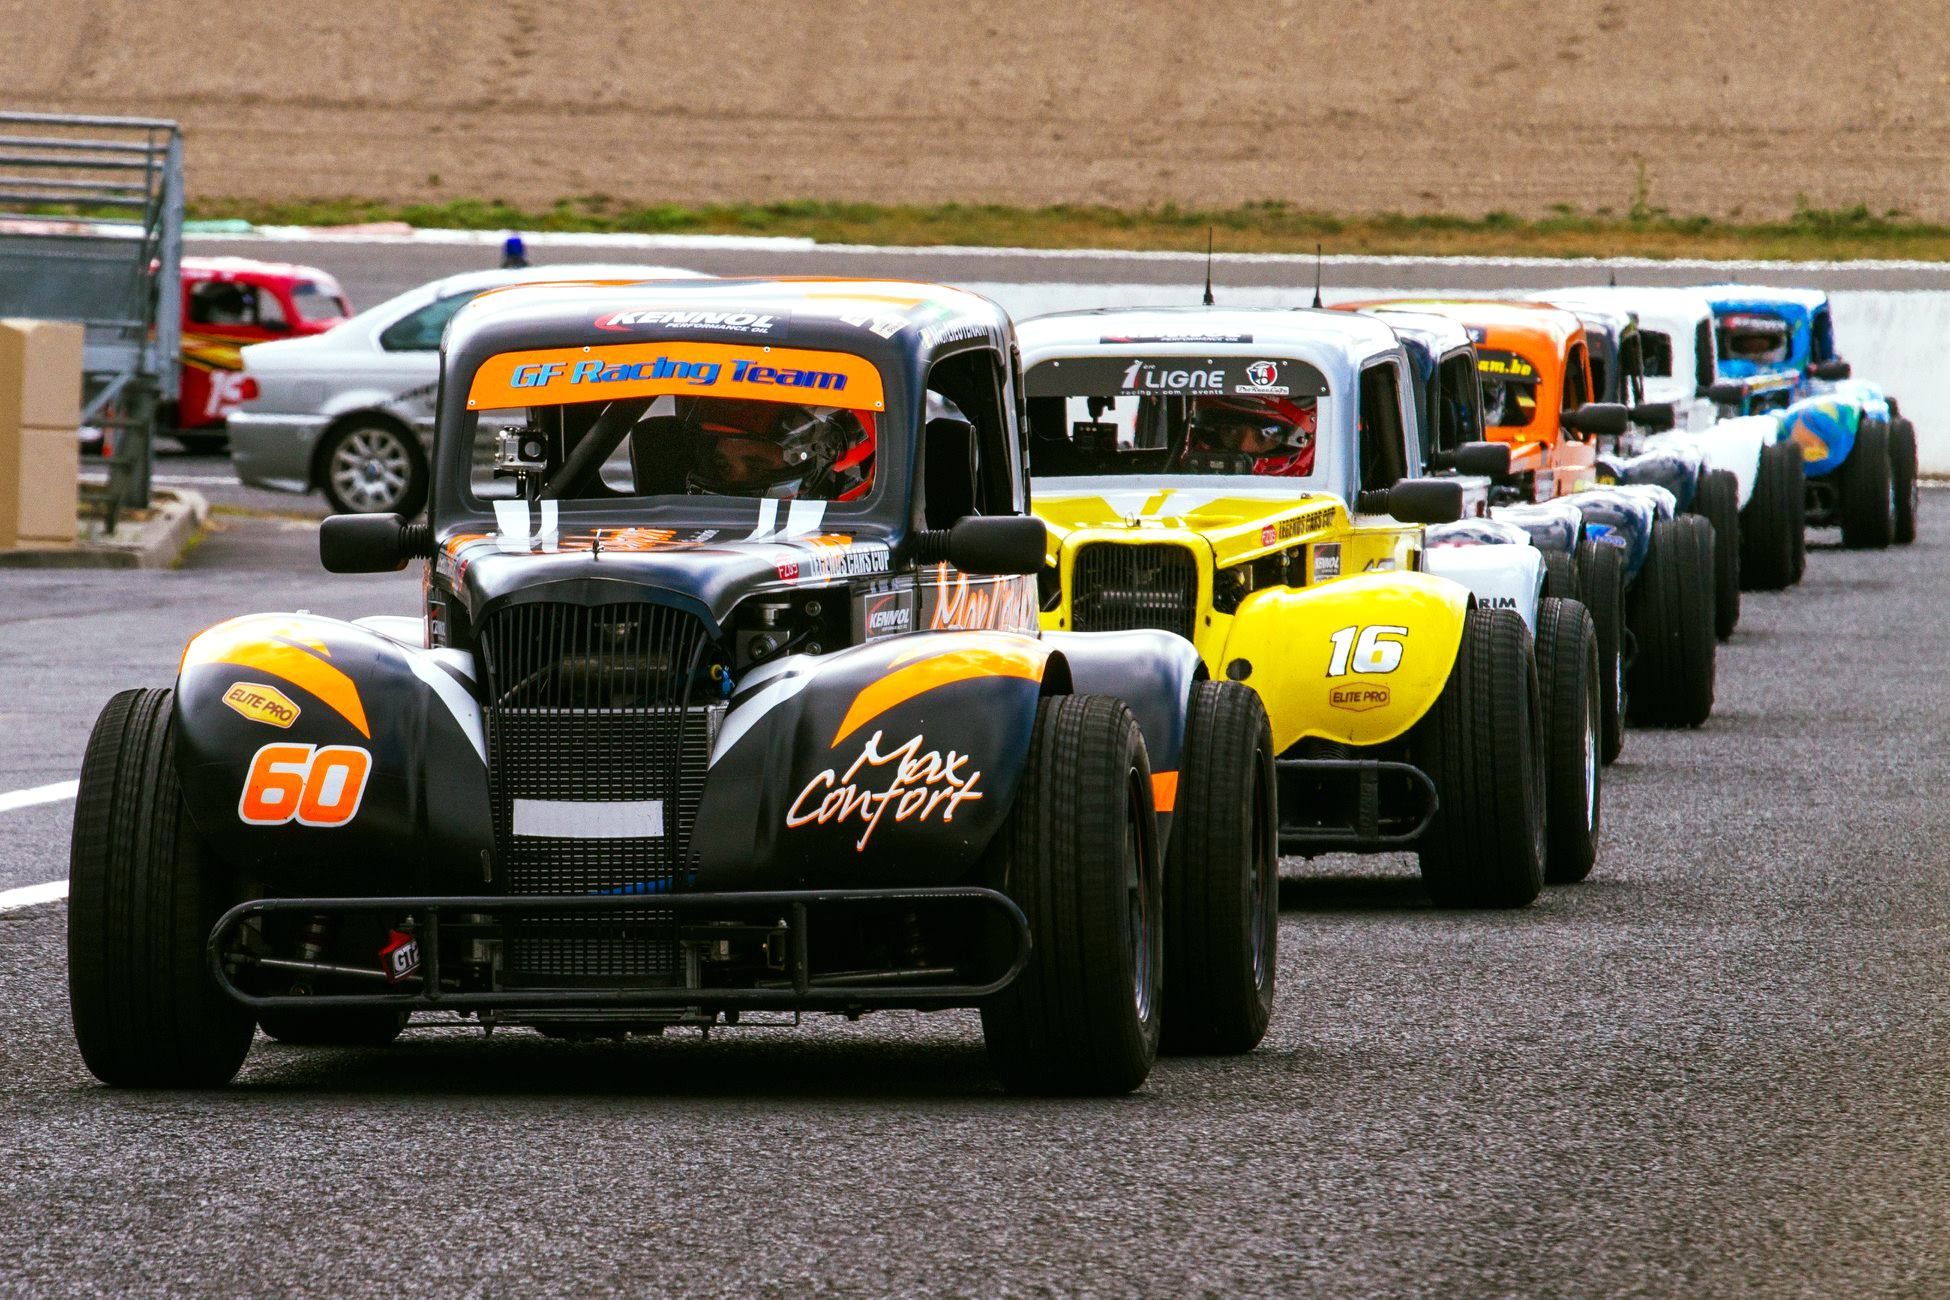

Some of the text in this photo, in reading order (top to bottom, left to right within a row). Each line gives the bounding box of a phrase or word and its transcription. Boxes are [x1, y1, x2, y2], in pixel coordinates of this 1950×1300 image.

[606, 311, 773, 328] KENNOL
[665, 323, 750, 332] PERFORMANCE
[510, 356, 849, 391] GF Racing Team
[1145, 370, 1226, 388] LIGNE
[870, 548, 890, 573] CUP
[869, 608, 910, 629] KENNOL
[1325, 624, 1409, 677] 16
[229, 688, 293, 721] ELITE PRO
[1333, 690, 1388, 703] ELITE PRO
[841, 730, 969, 787] Max
[238, 742, 373, 828] 60
[786, 766, 984, 852] Confort
